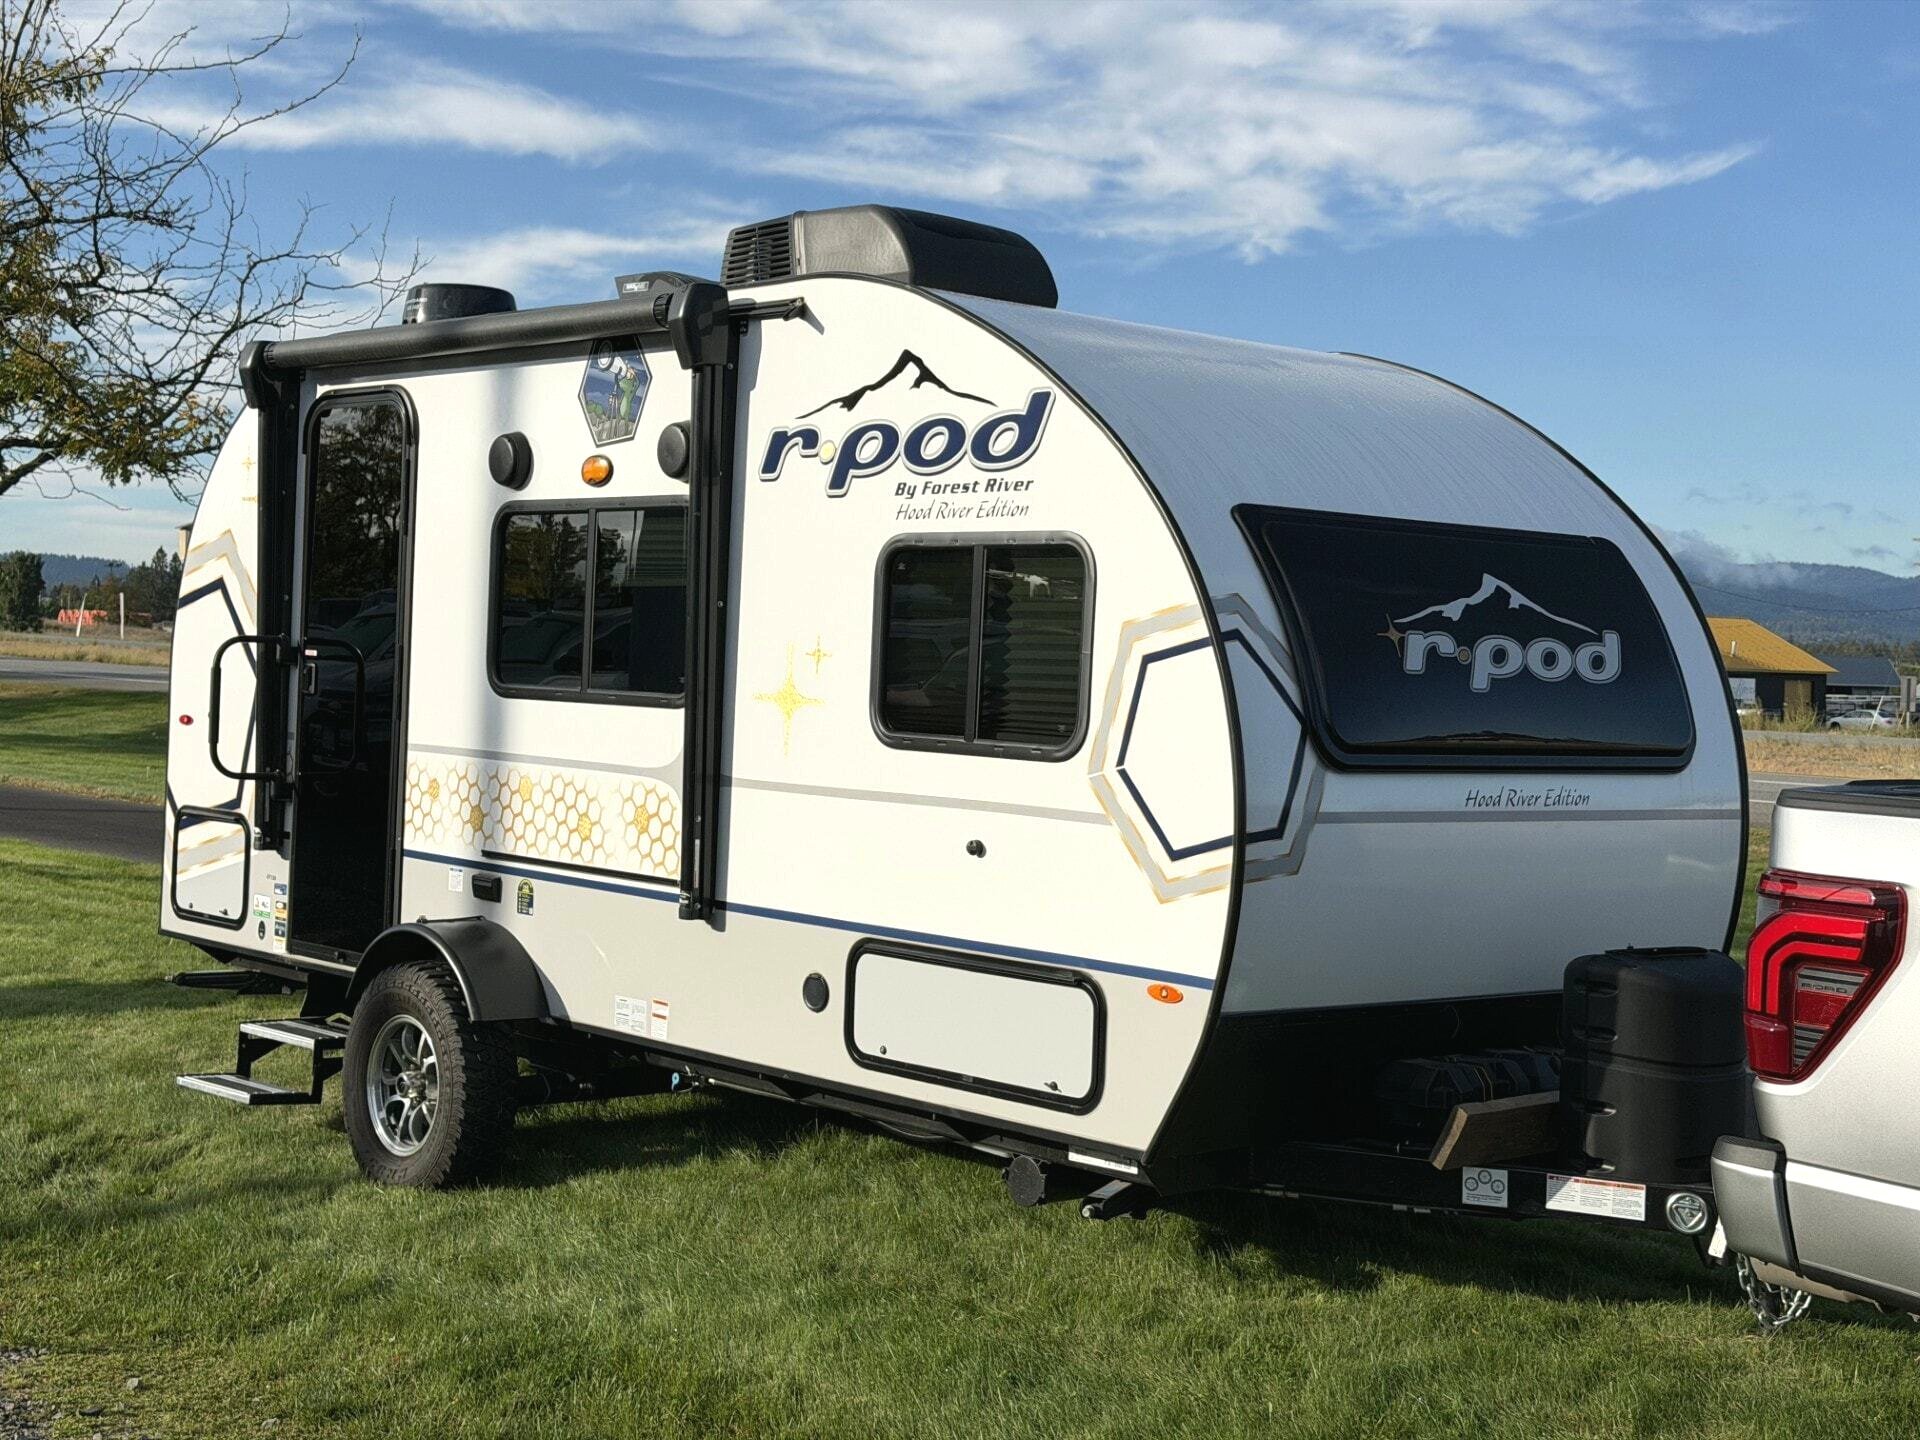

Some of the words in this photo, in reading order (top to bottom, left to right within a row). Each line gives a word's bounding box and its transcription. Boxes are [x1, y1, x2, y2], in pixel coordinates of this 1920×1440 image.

[894, 481, 918, 500] By
[921, 480, 981, 496] Forest
[984, 477, 1035, 493] River
[895, 499, 936, 521] Hood
[935, 501, 974, 520] River
[976, 496, 1030, 519] Edition
[1464, 785, 1505, 808] Hood
[1505, 788, 1542, 808] River
[1543, 785, 1591, 808] Edition
